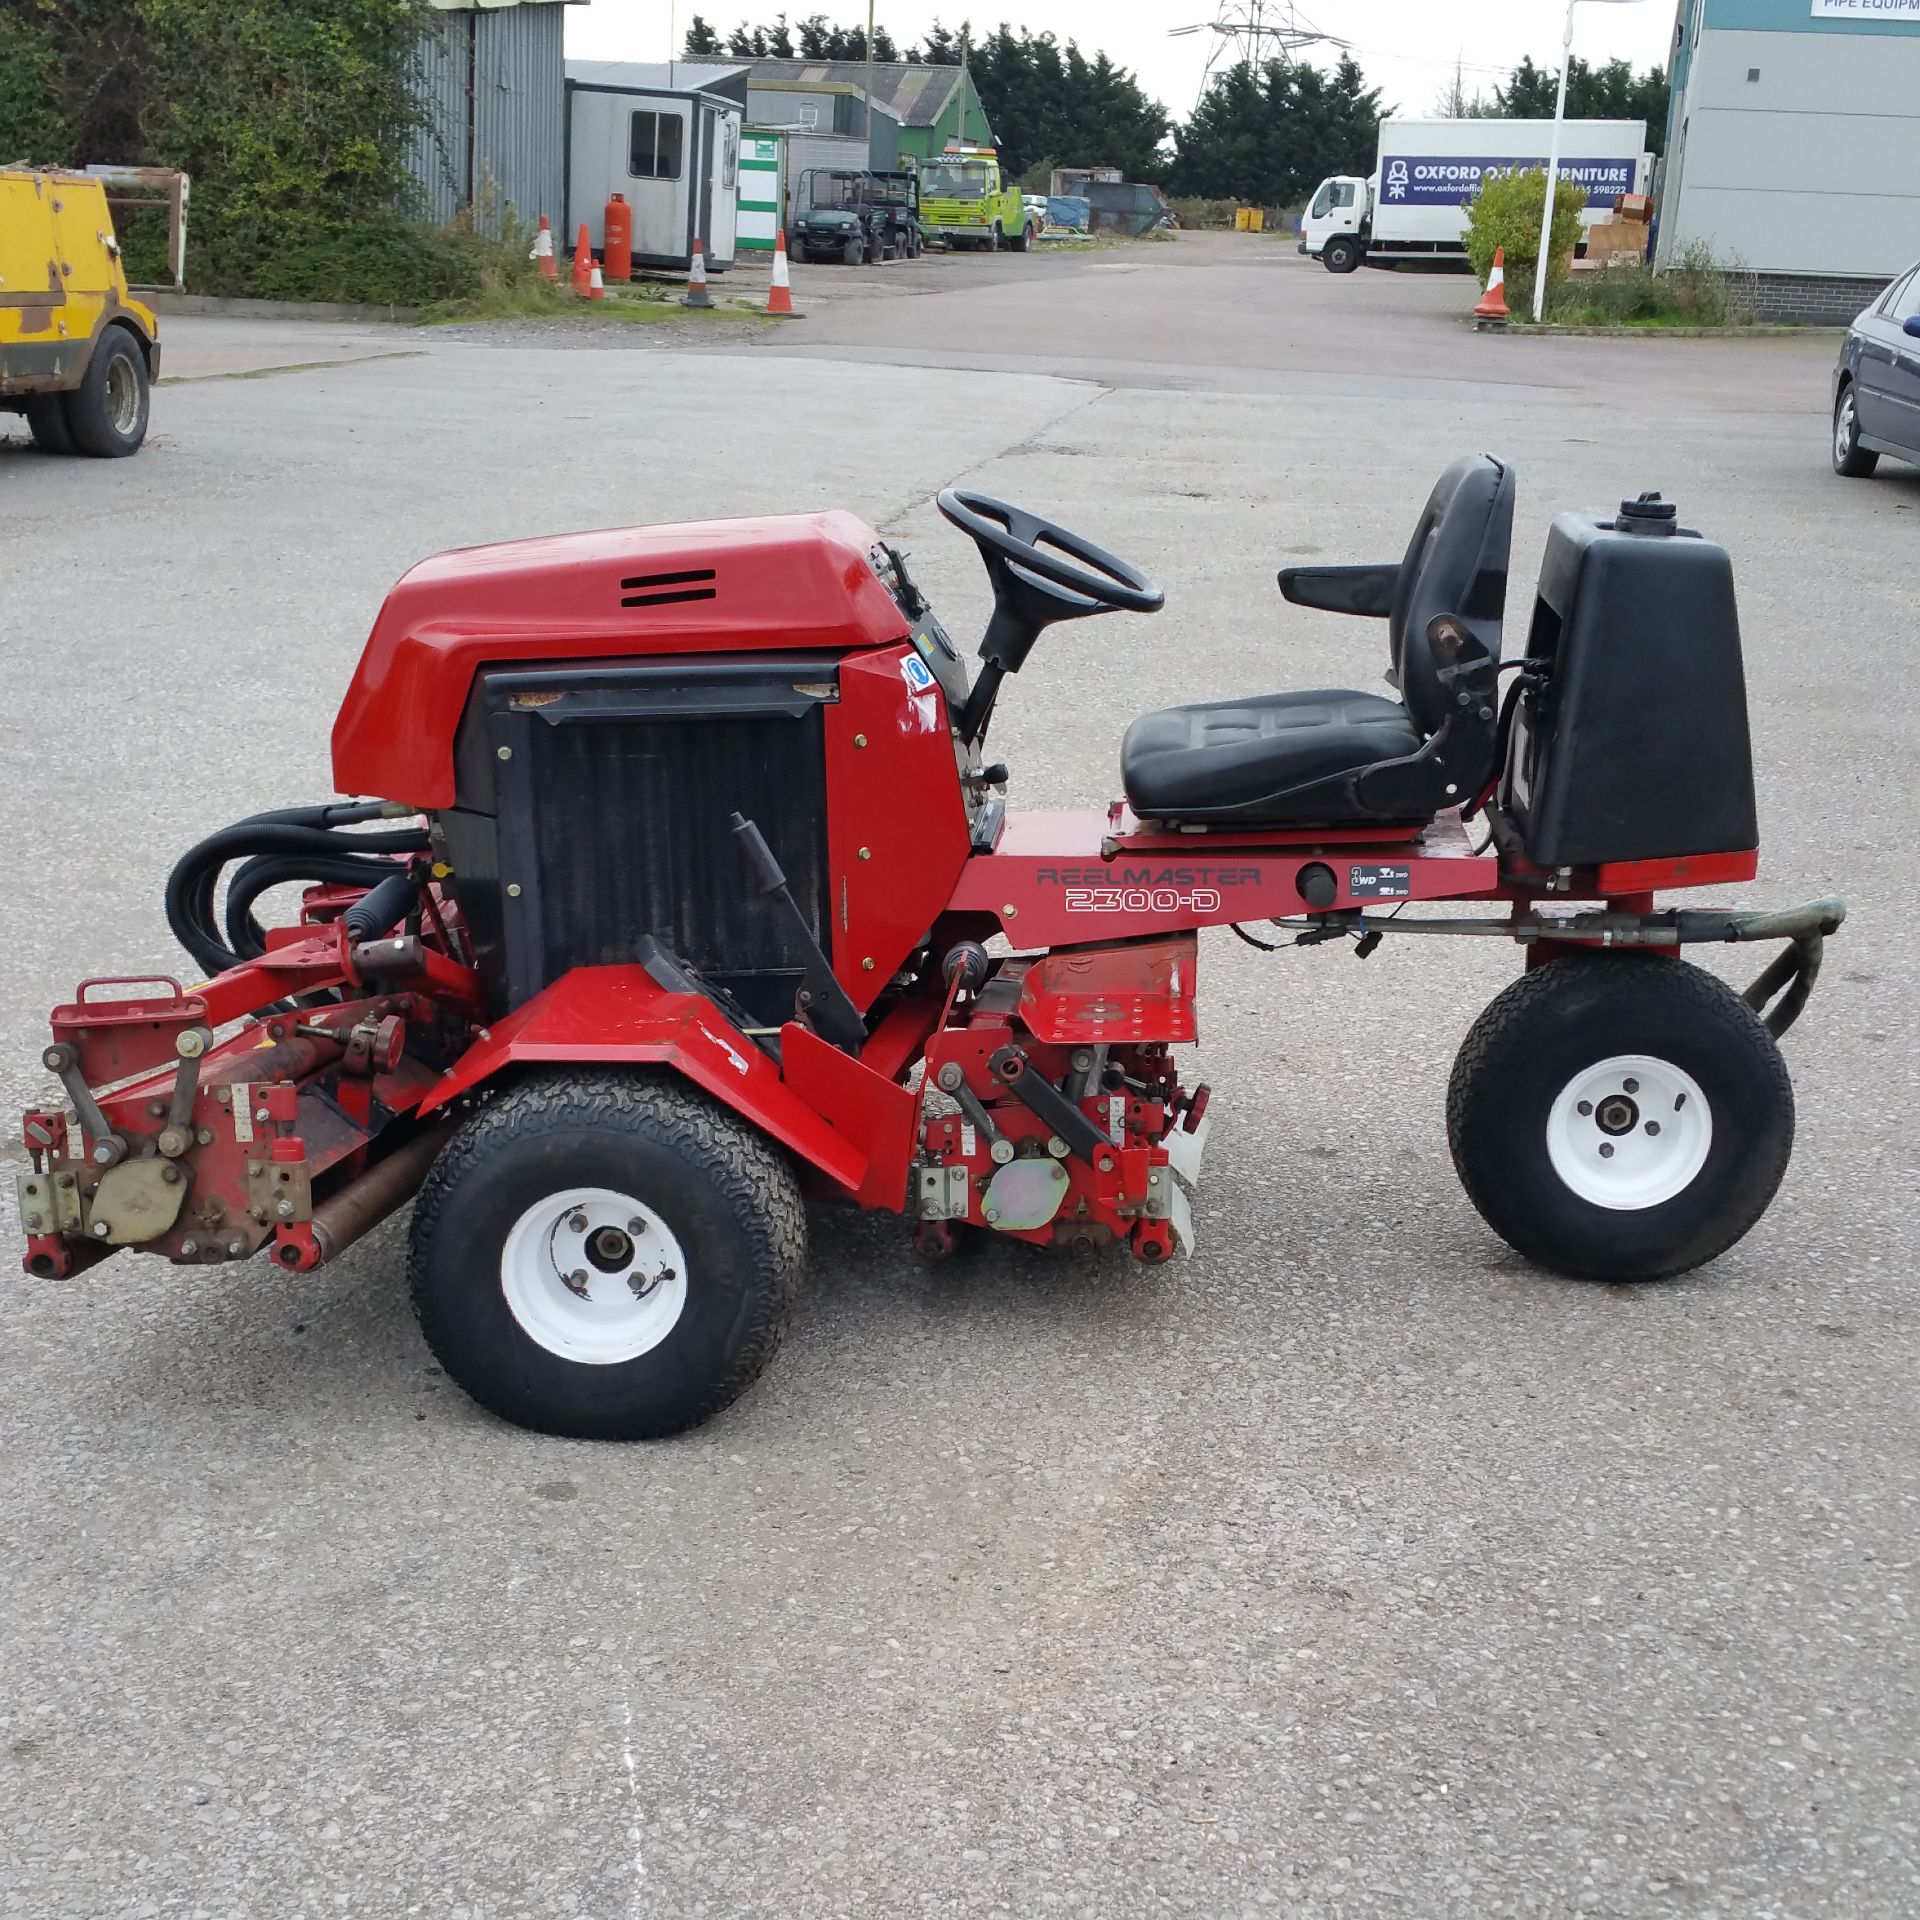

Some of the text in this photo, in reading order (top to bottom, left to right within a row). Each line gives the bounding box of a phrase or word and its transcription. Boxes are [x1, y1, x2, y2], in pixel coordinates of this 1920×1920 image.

[1414, 165, 1481, 180] OXFORD
[1593, 185, 1627, 195] 598222
[1036, 867, 1262, 886] REELMASTER
[1351, 866, 1377, 887] 3WD
[1065, 888, 1221, 912] 2300-D
